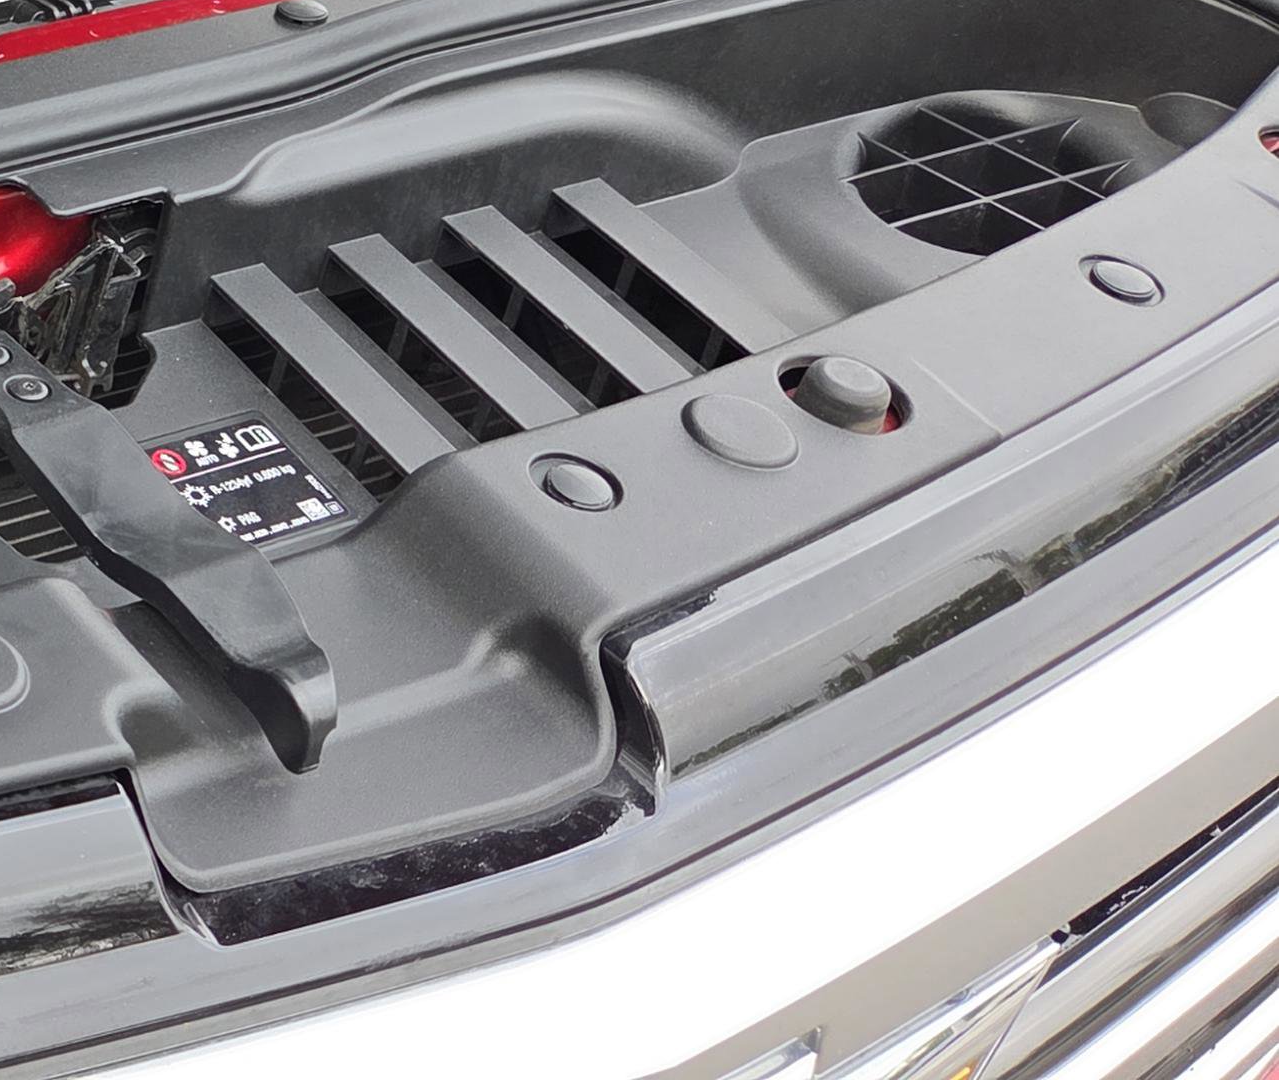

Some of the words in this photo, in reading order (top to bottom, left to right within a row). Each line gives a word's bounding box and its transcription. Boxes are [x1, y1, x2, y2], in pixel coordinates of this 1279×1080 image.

[195, 454, 220, 467] AUTO
[278, 464, 297, 475] kg
[236, 511, 262, 526] PAG
